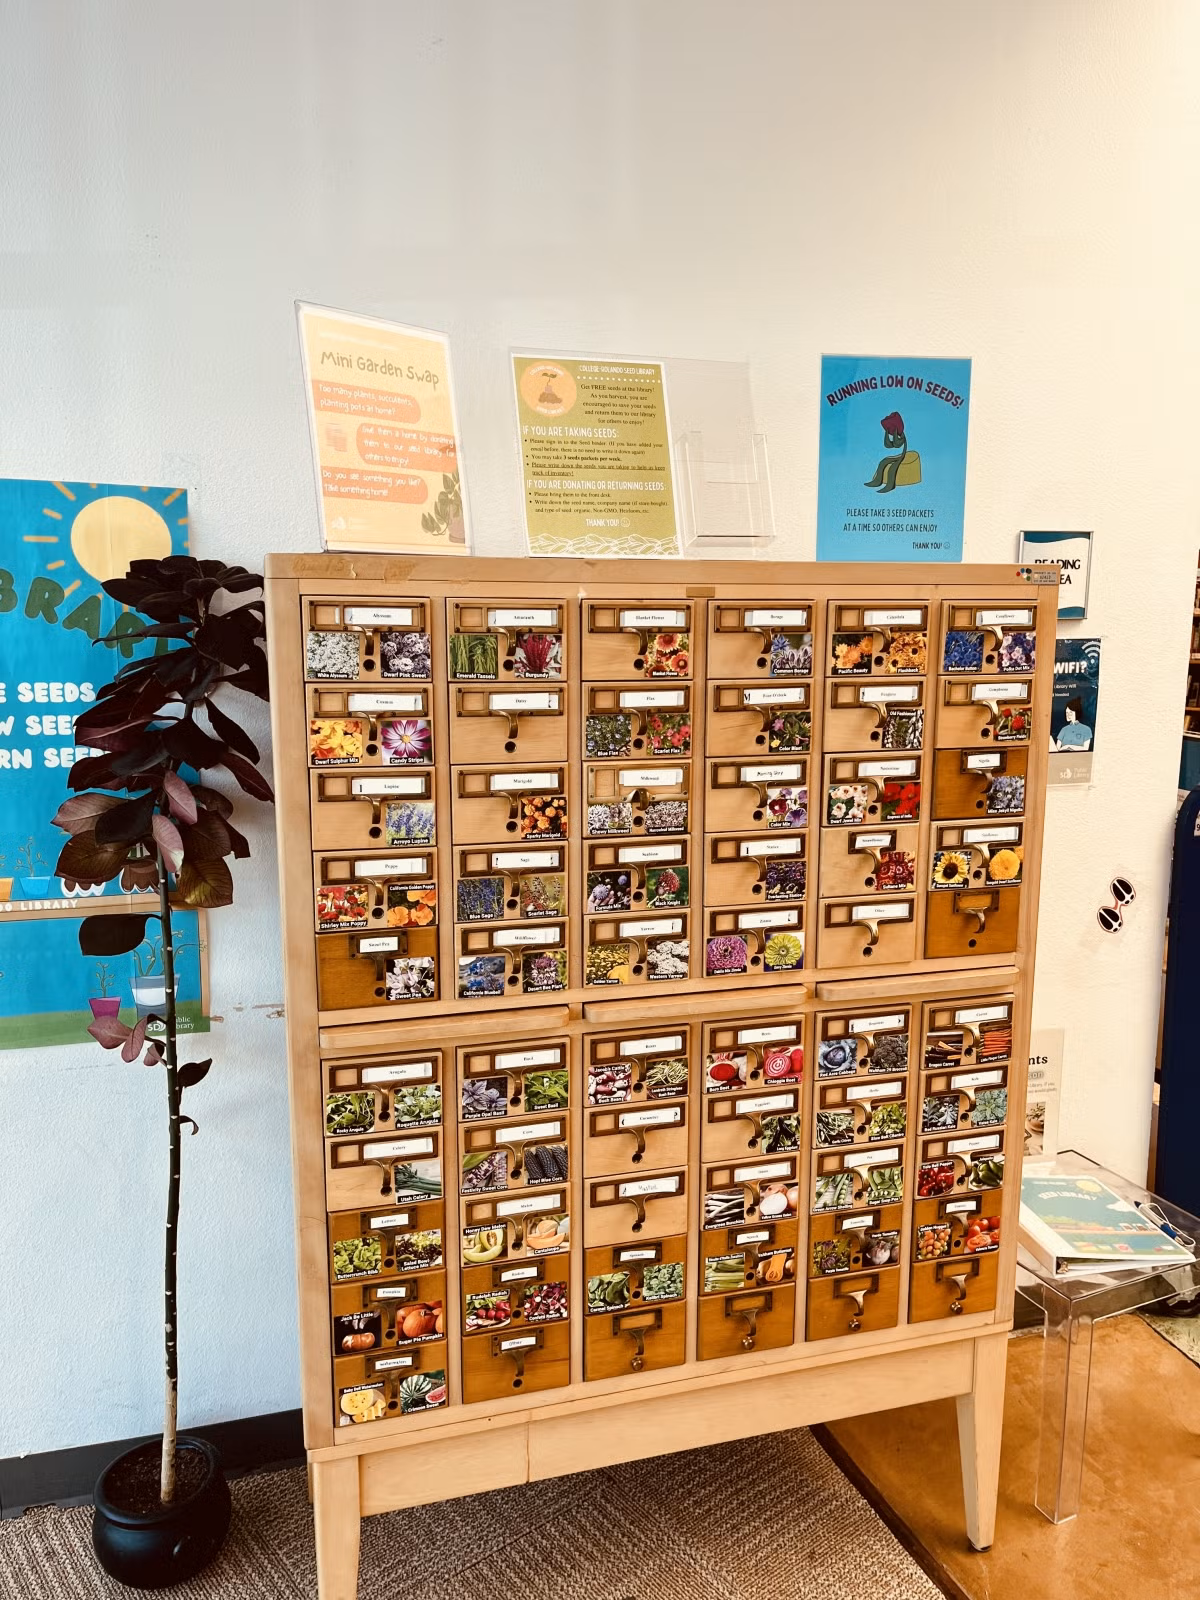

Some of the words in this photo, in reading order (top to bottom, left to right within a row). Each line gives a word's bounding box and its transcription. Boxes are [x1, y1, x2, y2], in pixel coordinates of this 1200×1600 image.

[321, 351, 352, 368] Mini
[357, 357, 403, 377] Garden
[407, 366, 439, 391] Swap
[320, 384, 331, 393] Too
[333, 385, 352, 398] many
[826, 377, 878, 406] RUNNING
[880, 375, 904, 388] LOW
[906, 376, 924, 391] ON
[925, 381, 964, 409] SEEDS!
[320, 399, 349, 413] planting
[350, 403, 365, 412] pots
[583, 401, 611, 409] encouraged
[640, 411, 656, 419] library
[523, 425, 529, 435] IF
[531, 426, 546, 436] YOU
[547, 427, 562, 436] ARE
[565, 427, 592, 438] TAKING
[594, 428, 619, 439] SEEDS:
[430, 435, 453, 448] donating
[323, 470, 331, 478] Do
[363, 474, 392, 486] something
[396, 477, 406, 486] you
[324, 482, 338, 492] Take
[340, 484, 370, 498] something
[526, 480, 532, 488] IF
[534, 480, 547, 489] YOU
[548, 480, 560, 489] ARE
[562, 480, 596, 490] DONATING
[597, 481, 606, 490] OR
[607, 481, 643, 490] RETURNING
[644, 482, 666, 490] SEEDS:
[846, 509, 868, 517] PLEASE
[870, 509, 885, 517] TAKE
[887, 509, 890, 517] 3
[892, 509, 907, 517] SEED
[908, 509, 934, 518] PACKETS
[606, 519, 620, 527] YOU!
[858, 523, 871, 532] TIME
[872, 524, 881, 532] SO
[882, 524, 904, 532] OTHERS
[905, 524, 919, 532] CAN
[920, 524, 938, 532] ENJOY
[912, 542, 930, 550] THANK
[930, 542, 942, 550] YOU!
[1054, 661, 1087, 673] WIFI?
[17, 682, 96, 703] SEEDS
[21, 900, 78, 910] LIBRARY
[1060, 1191, 1097, 1201] LIBRARY
[422, 1333, 442, 1342] Pumpkin
